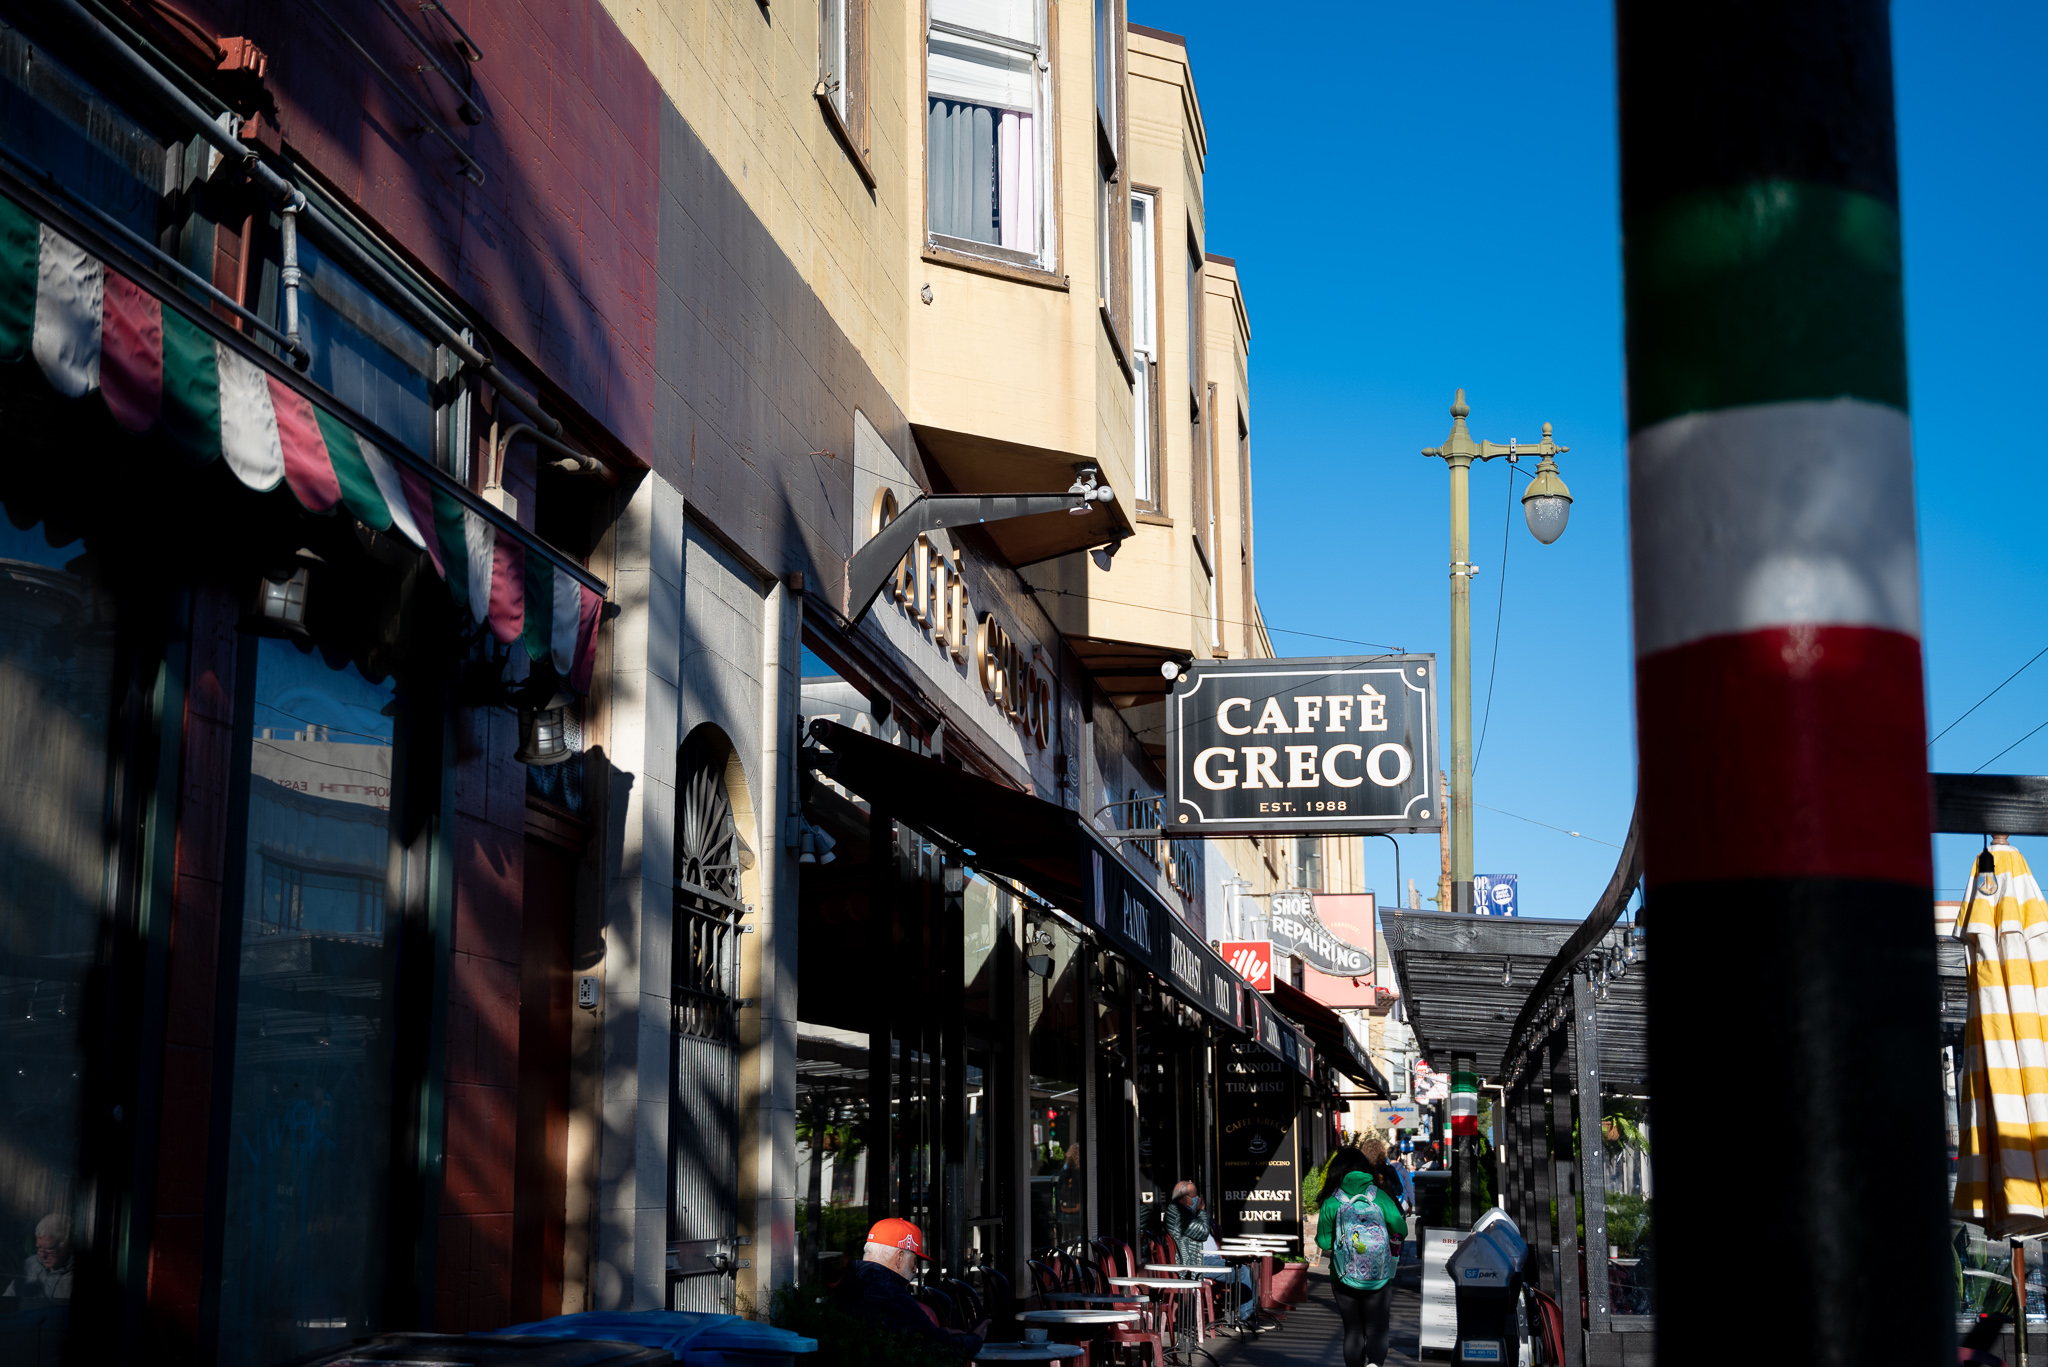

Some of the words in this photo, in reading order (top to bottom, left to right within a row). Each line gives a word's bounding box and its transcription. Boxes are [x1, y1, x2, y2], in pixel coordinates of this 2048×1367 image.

[978, 612, 1050, 750] GRECO
[1216, 684, 1388, 736] CAFFÈ
[1193, 743, 1412, 790] GRECO
[1260, 802, 1297, 813] EST.
[1306, 801, 1348, 812] 1988
[1273, 898, 1311, 916] SHOE
[1272, 916, 1361, 969] REPAIRING
[1170, 932, 1202, 996] BREAKFAST
[1229, 949, 1269, 985] illy
[1226, 1062, 1282, 1074] CANNOLI
[1225, 1081, 1285, 1093] TIRAMISÙ
[1256, 1117, 1289, 1134] GRECO
[1225, 1189, 1292, 1201] BREAKFAST
[1239, 1210, 1282, 1221] LUNCH
